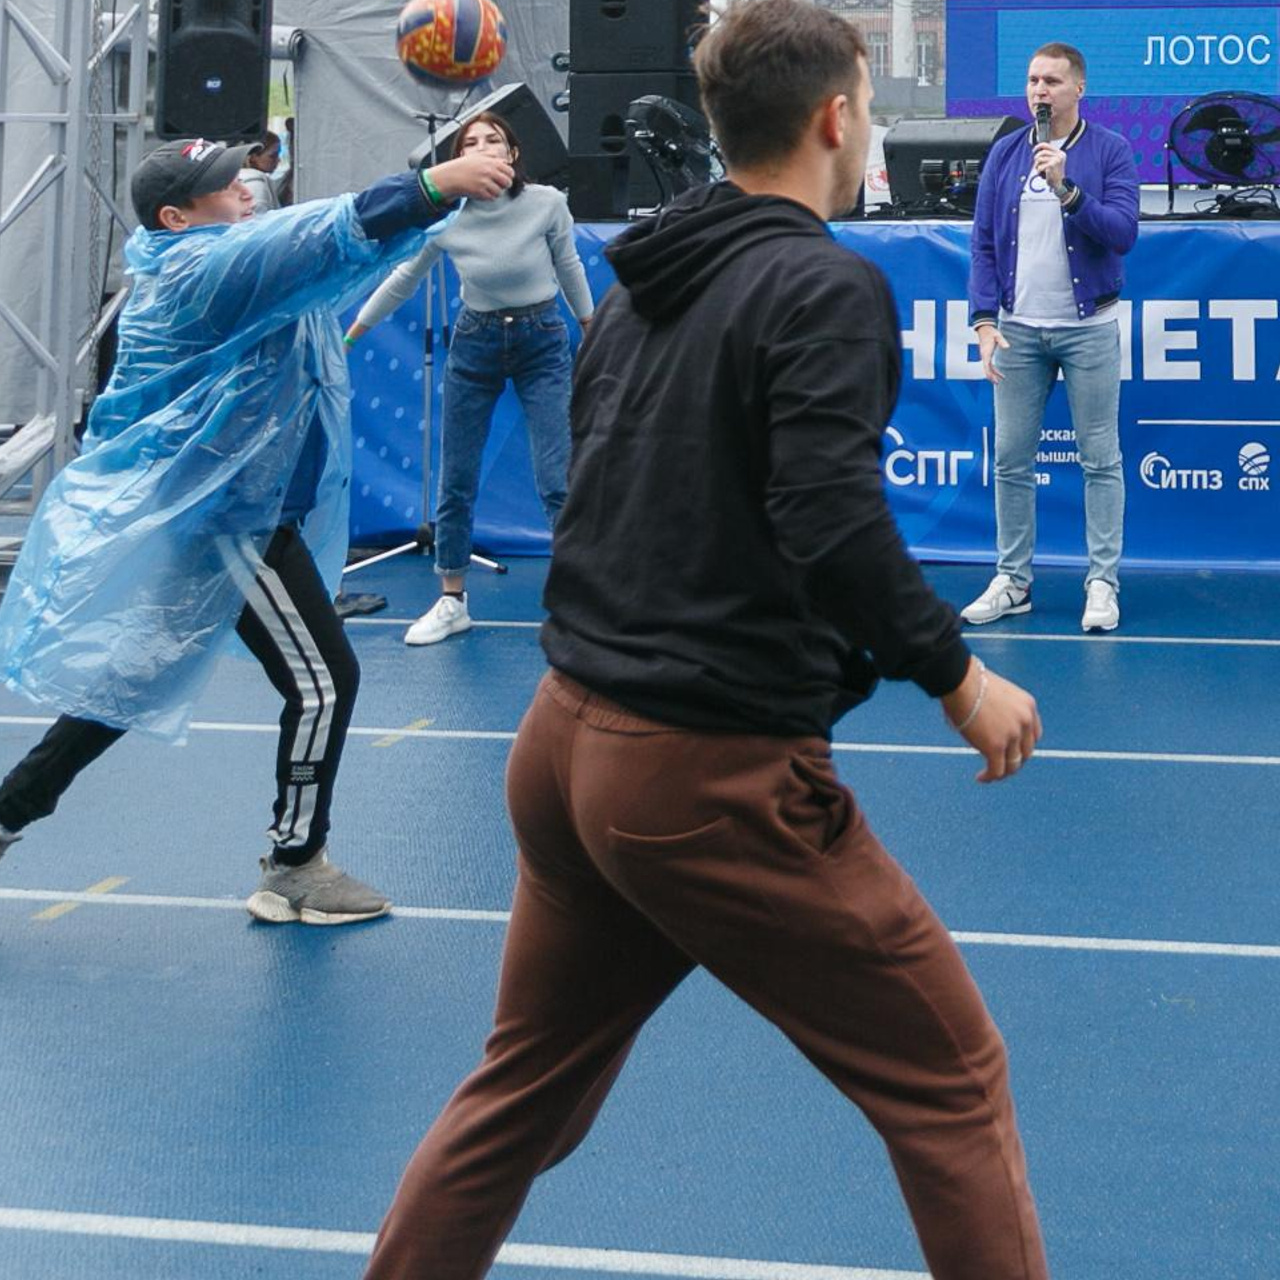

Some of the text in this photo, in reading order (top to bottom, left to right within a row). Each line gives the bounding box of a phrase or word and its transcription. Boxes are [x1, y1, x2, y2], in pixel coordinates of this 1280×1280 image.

[1143, 34, 1271, 66] ЛОТОС
[885, 449, 975, 486] СПГ
[1238, 477, 1271, 491] СПХ
